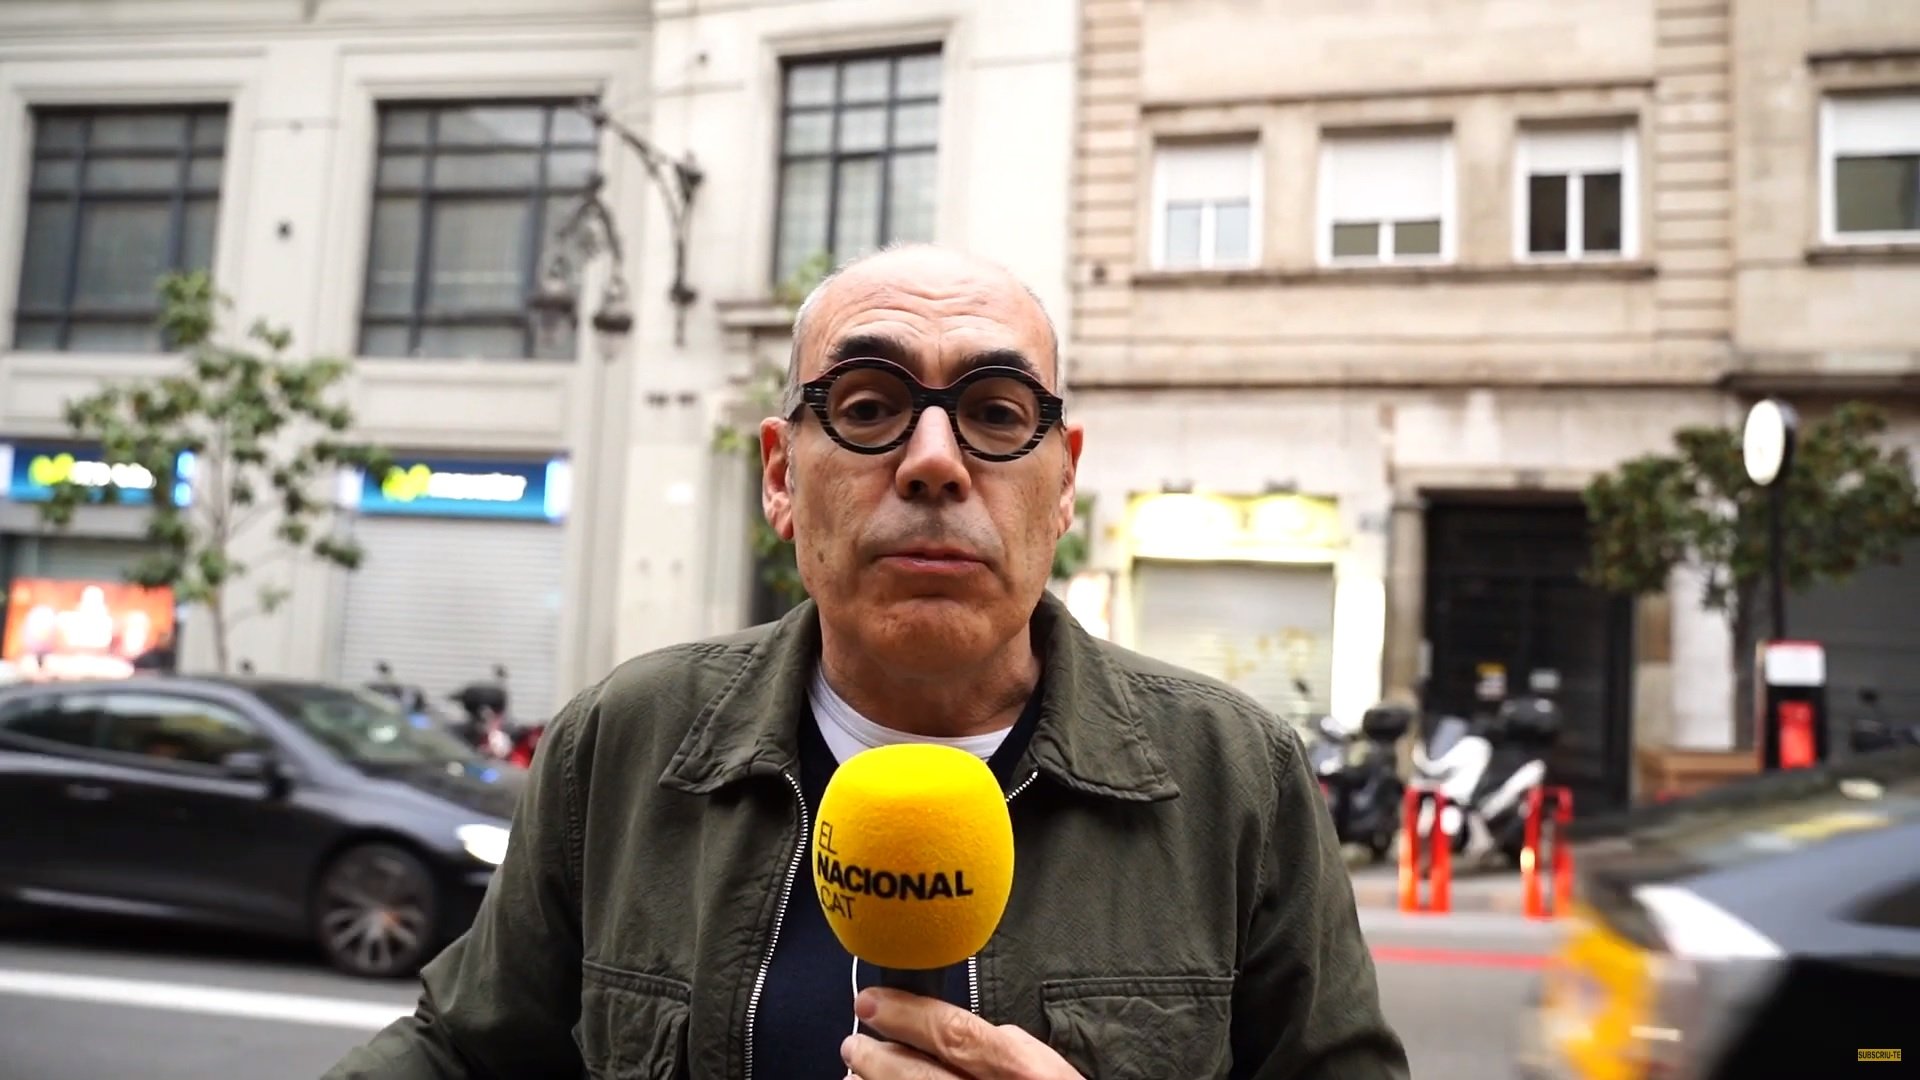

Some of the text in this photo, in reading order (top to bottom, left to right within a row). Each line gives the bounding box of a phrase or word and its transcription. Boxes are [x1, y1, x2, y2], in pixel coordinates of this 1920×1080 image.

[818, 820, 837, 854] EL
[817, 851, 973, 901] NACIONAL
[820, 886, 855, 919] CAT
